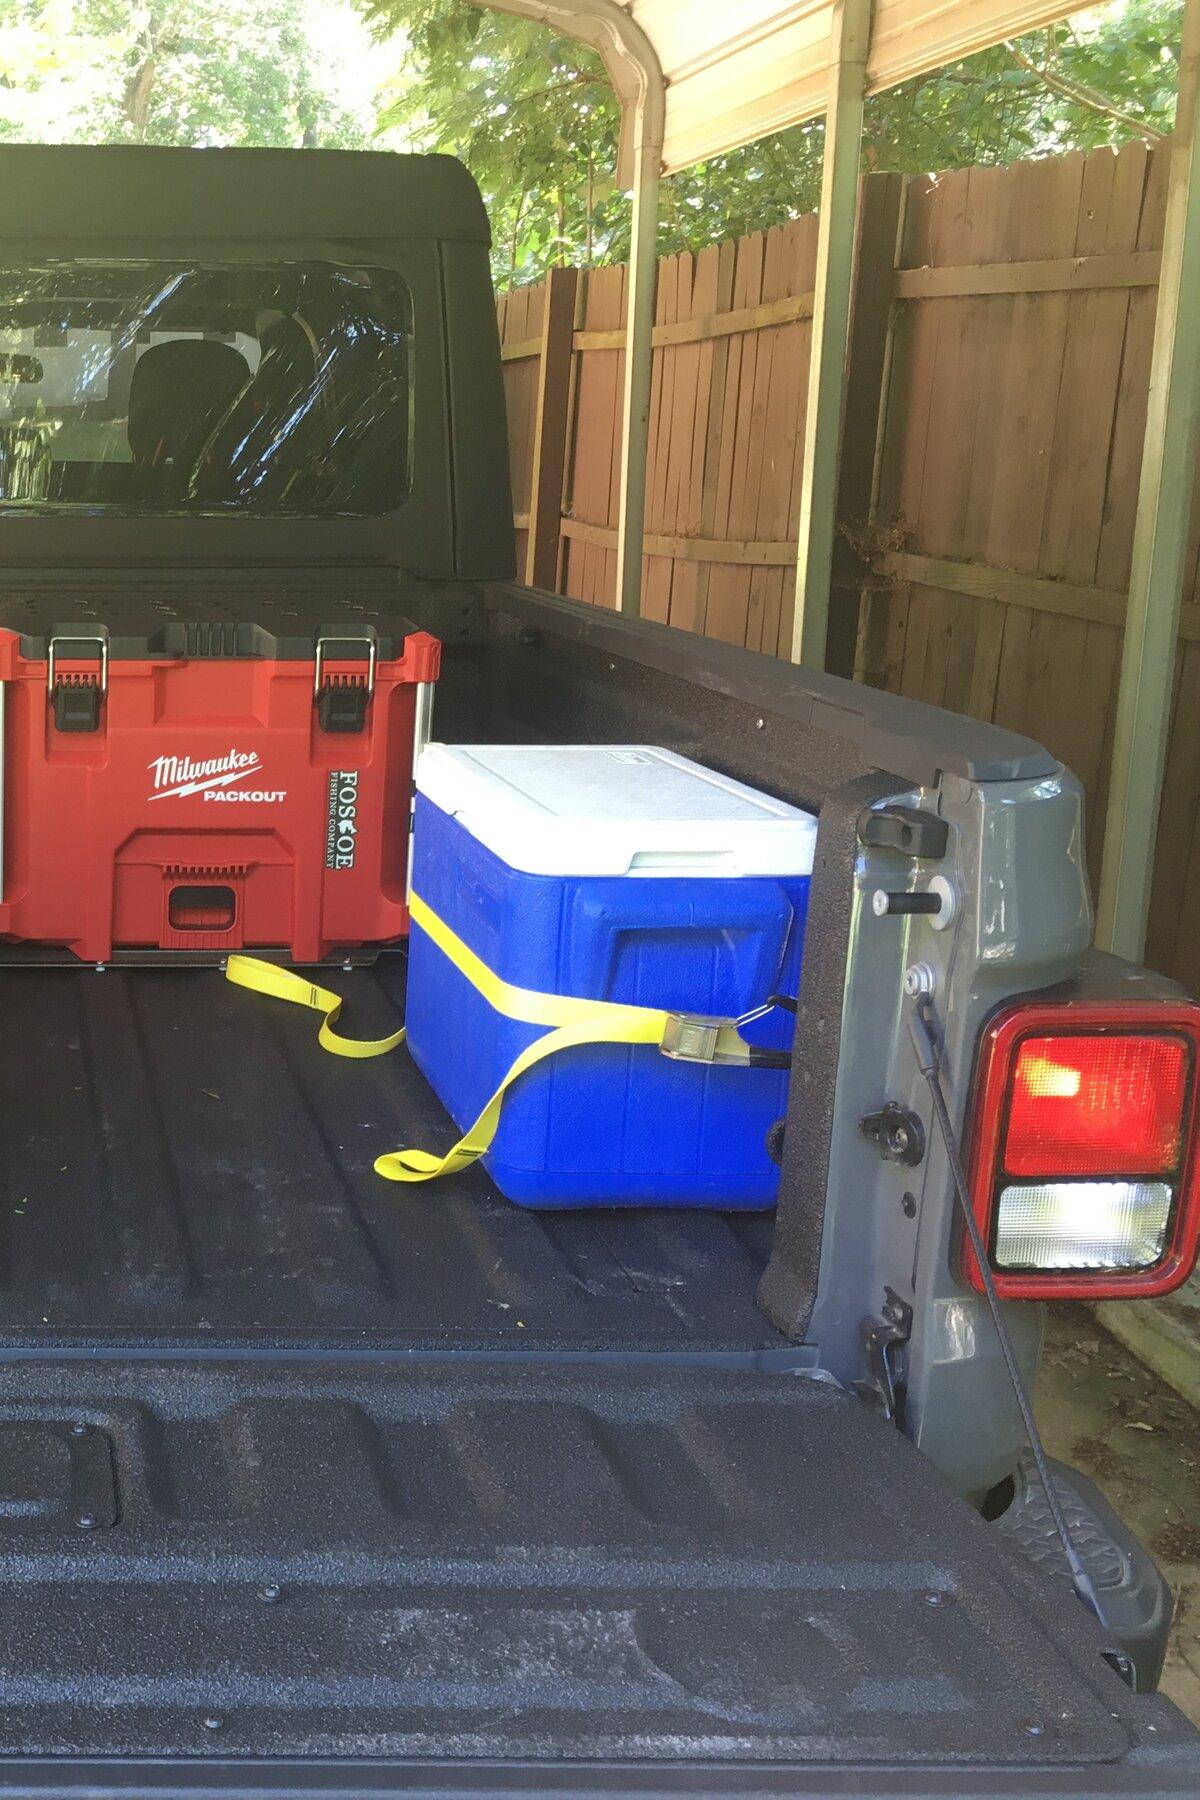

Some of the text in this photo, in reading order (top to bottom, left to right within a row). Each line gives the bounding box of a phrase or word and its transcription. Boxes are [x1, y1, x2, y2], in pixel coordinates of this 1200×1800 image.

[147, 749, 260, 789] Milwaukee
[203, 791, 287, 802] PACKOUT
[326, 772, 338, 869] FISHING COMPANY
